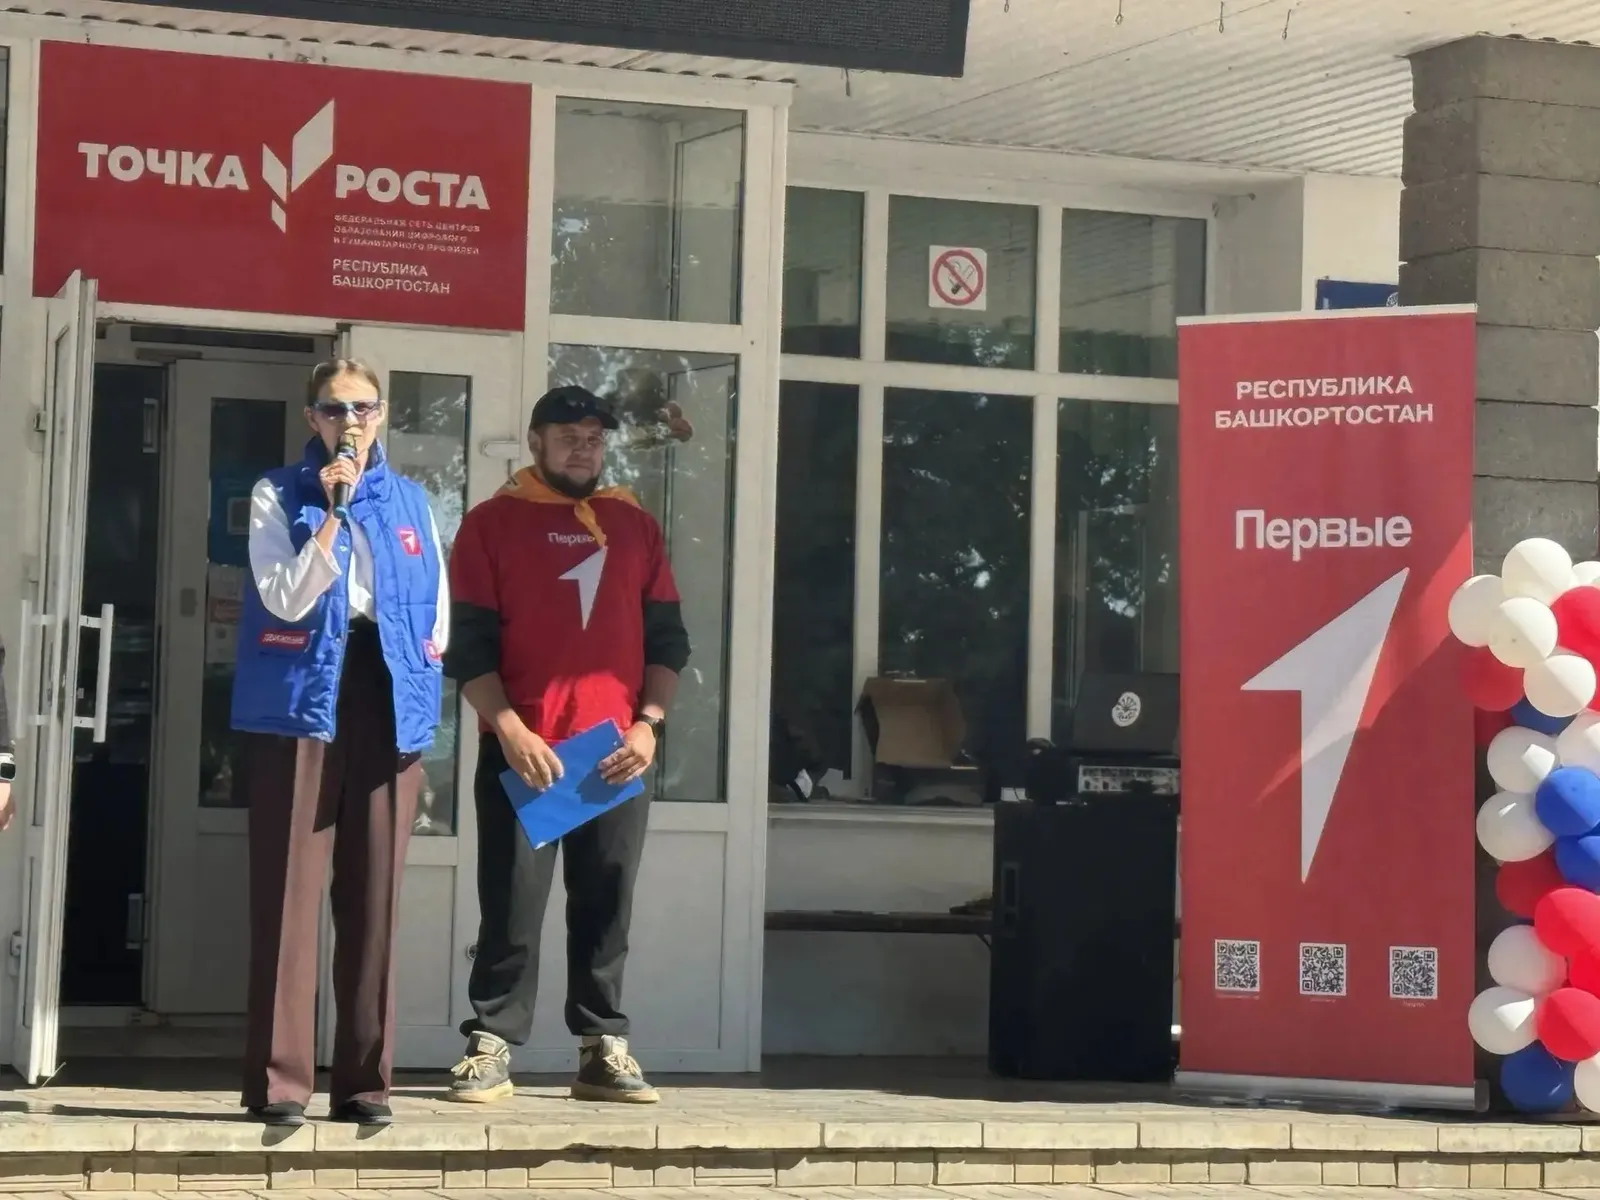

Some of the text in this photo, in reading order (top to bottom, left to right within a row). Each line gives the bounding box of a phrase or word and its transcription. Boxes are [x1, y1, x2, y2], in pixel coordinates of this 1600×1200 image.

[78, 141, 491, 211] ТОЧКА РОСТА
[334, 214, 406, 228] ФЕДЕРАЛЬНАЯ
[334, 225, 405, 239] ОБРАЗОВАНИЯ
[332, 258, 429, 277] РЕСПУБЛИКА
[332, 274, 450, 295] БАШКОРТОСТАН
[1236, 375, 1414, 400] РЕСПУБЛИКА
[1215, 403, 1434, 429] БАШКОРТОСТАН
[1235, 508, 1413, 562] Первые
